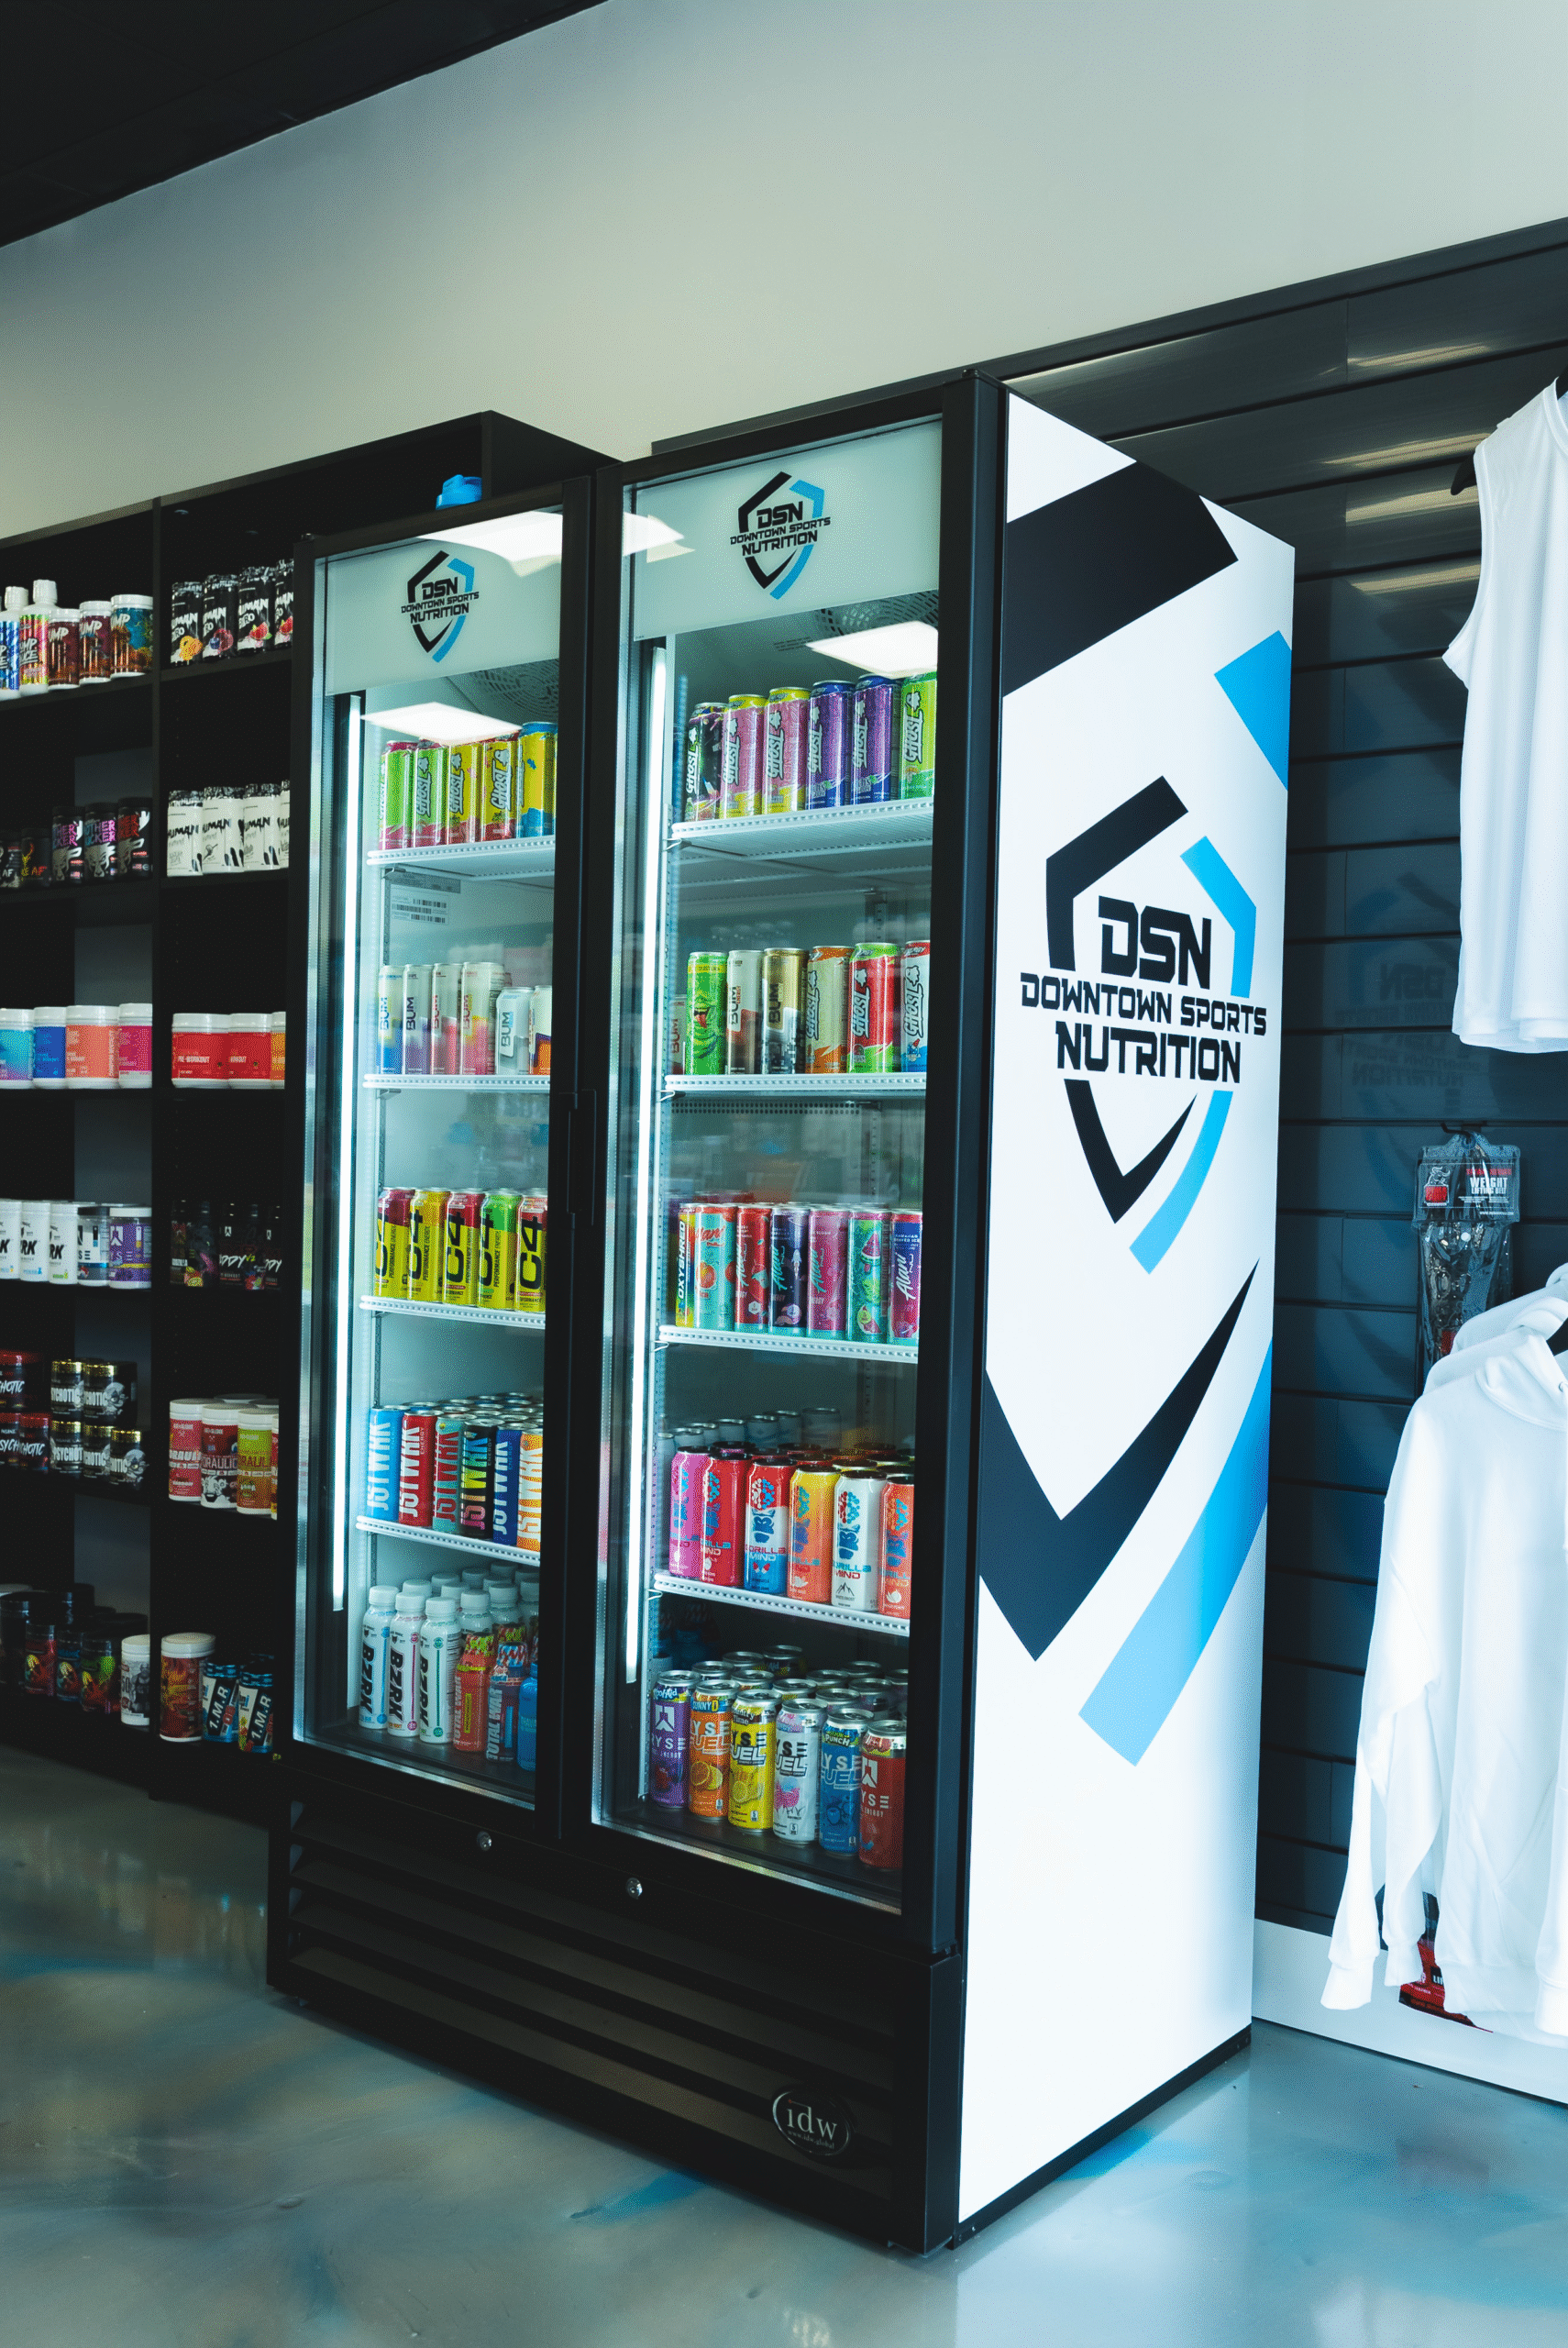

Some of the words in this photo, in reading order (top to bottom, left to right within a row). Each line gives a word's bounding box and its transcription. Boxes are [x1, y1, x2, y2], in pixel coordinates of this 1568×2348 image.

[730, 526, 787, 545] DOWNTOWN
[790, 516, 831, 533] SPORTS
[756, 501, 803, 529] DSN
[742, 530, 818, 556] NUTRITION
[401, 598, 445, 614] DOWNTOWN
[447, 592, 480, 604] SPORTS
[422, 577, 458, 600] DSN
[410, 603, 469, 624] NUTRITION
[903, 703, 924, 764] GHOST
[491, 759, 513, 811] GHOST
[1099, 895, 1211, 990] DSN
[405, 997, 416, 1031] BUM
[768, 983, 781, 1024] BUM
[852, 985, 870, 1039] GHOST
[903, 983, 924, 1038] GHOST
[1021, 972, 1172, 1024] DOWNTOWN
[1180, 995, 1266, 1036] SPORTS
[501, 1012, 512, 1047] BUM
[1055, 1021, 1241, 1083] NUTRITION
[1470, 1177, 1507, 1188] WEGHT
[446, 1212, 465, 1283] C4
[520, 1216, 543, 1290] C4
[896, 1252, 917, 1301] Alani
[749, 1553, 777, 1562] MIND
[360, 1642, 374, 1715] BZRK
[389, 1648, 404, 1722] BZRK
[825, 1733, 851, 1746] PUNCH
[787, 2103, 837, 2141] idw
